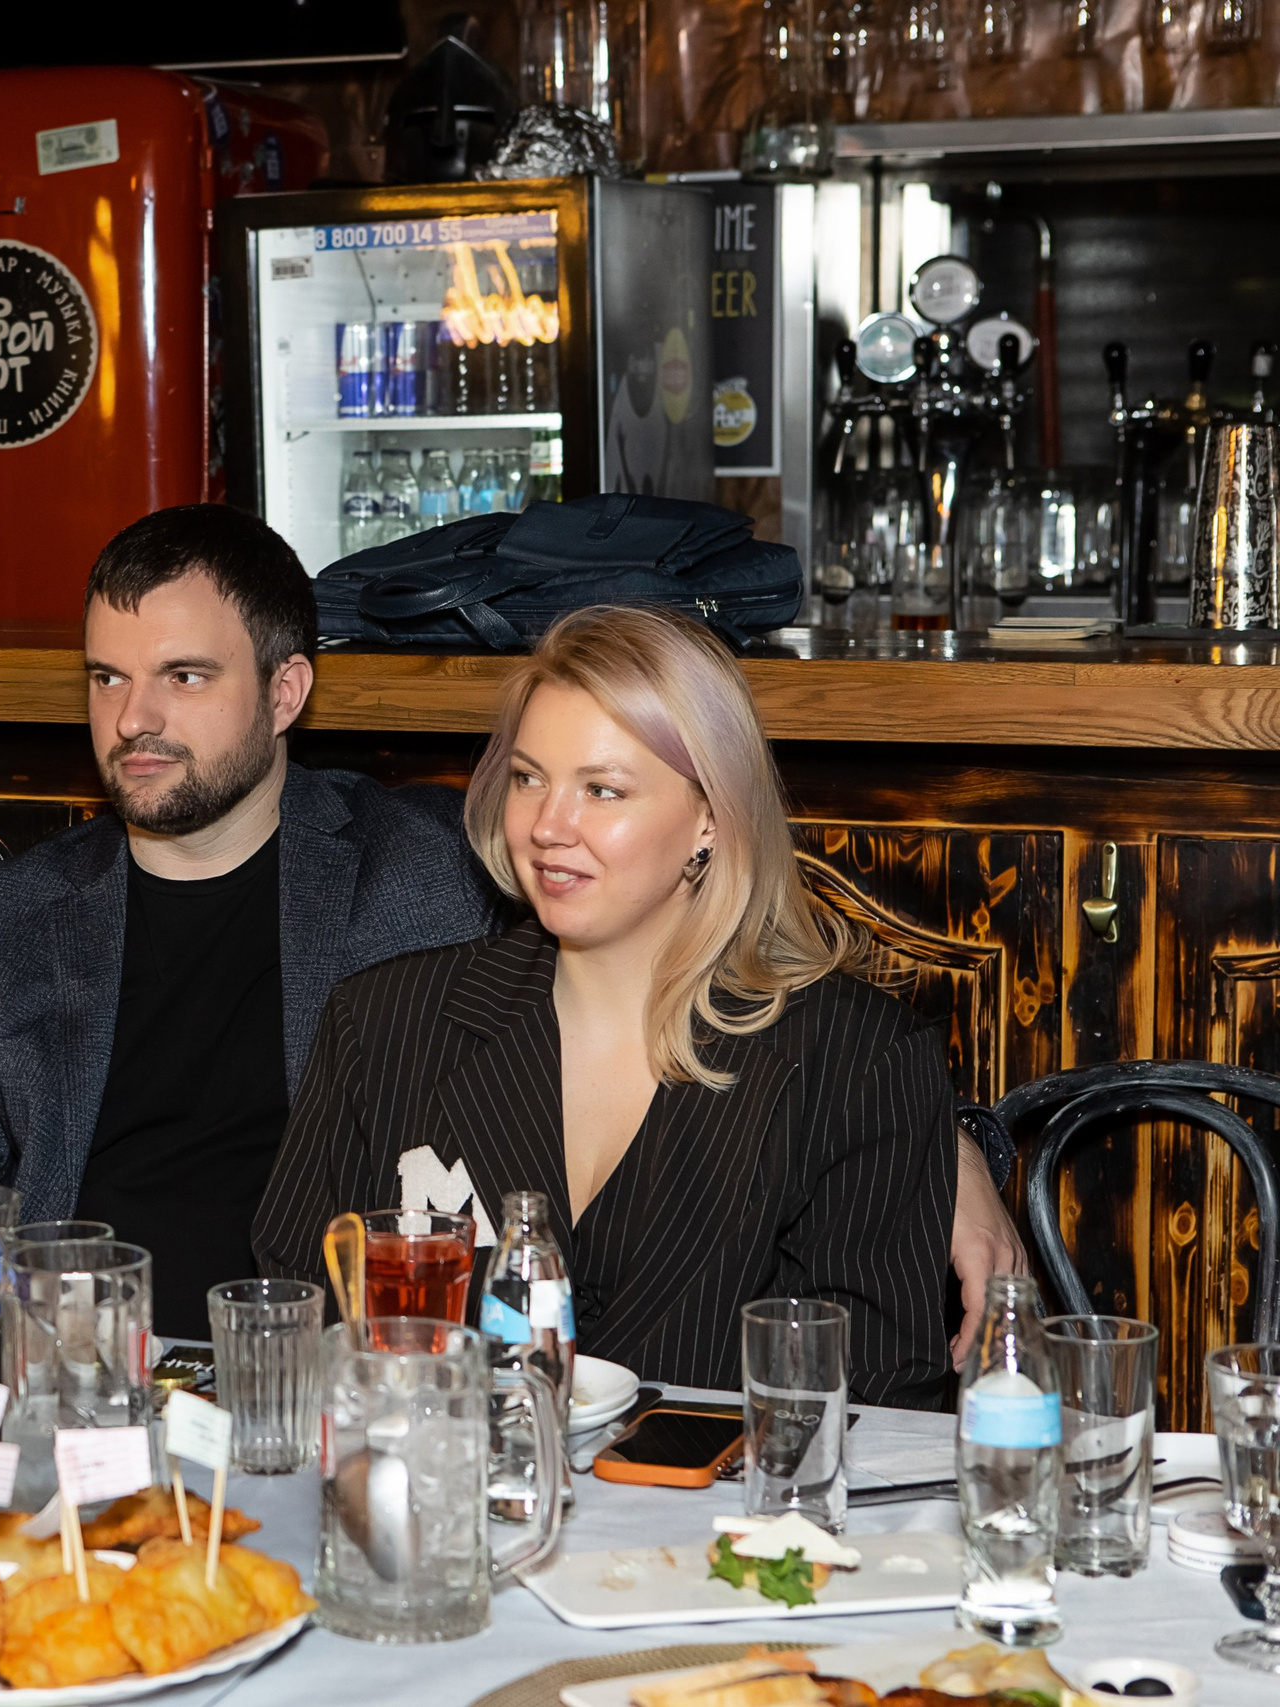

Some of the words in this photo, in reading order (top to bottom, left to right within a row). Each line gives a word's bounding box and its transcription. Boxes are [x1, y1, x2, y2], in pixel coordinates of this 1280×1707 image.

[331, 227, 367, 248] 800
[371, 224, 407, 246] 700
[411, 222, 432, 244] 14
[438, 221, 463, 242] 55
[714, 203, 758, 251] IME
[36, 271, 83, 345] МУЗЫКА
[711, 270, 758, 318] EER
[29, 368, 78, 426] КНИГИ
